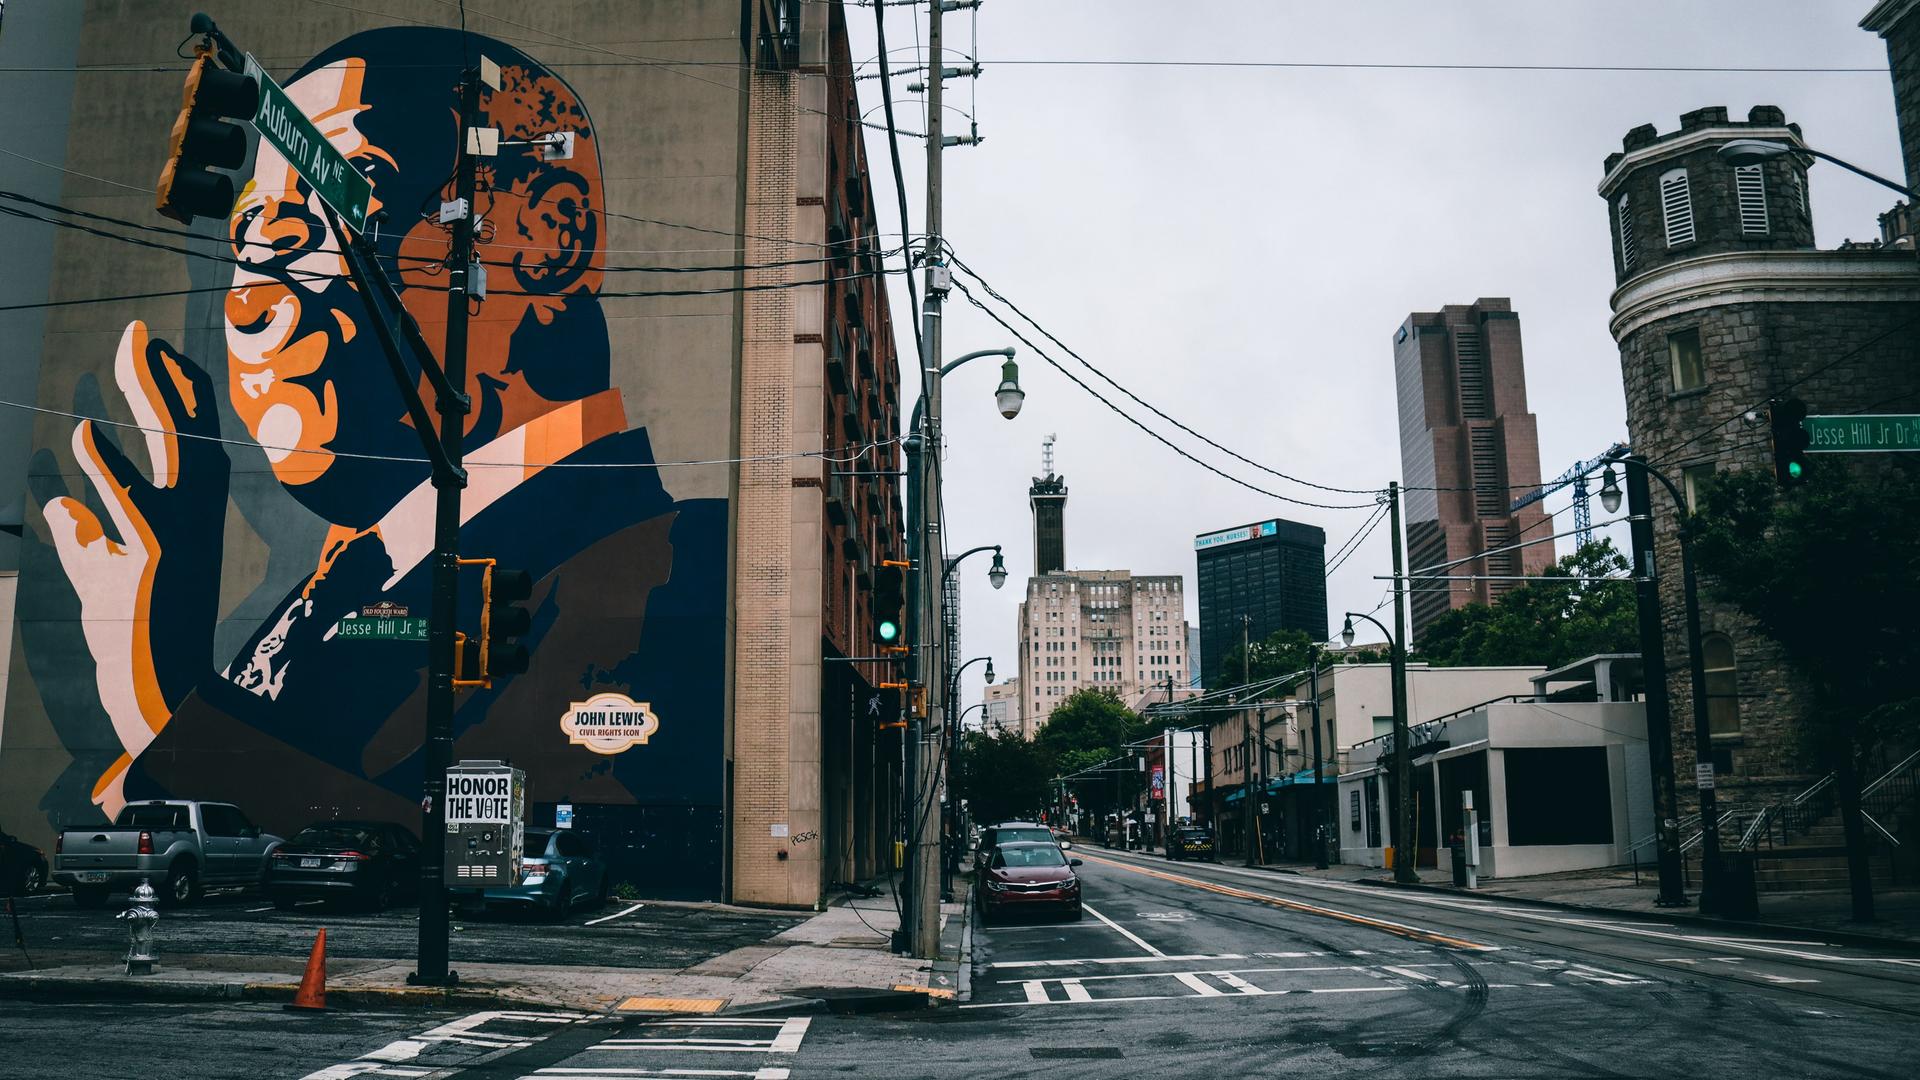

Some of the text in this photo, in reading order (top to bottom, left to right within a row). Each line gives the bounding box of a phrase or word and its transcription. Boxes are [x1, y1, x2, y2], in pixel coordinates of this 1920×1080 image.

[259, 89, 345, 185] Auburn Av NE
[1809, 422, 1909, 445] Jesse Hill Jr Dr
[1196, 539, 1212, 547] THANK
[338, 620, 371, 635] Jesse
[377, 620, 394, 635] Hill
[419, 620, 426, 628] DR
[418, 629, 427, 637] NE
[575, 711, 645, 726] JOHN LEWIS
[579, 729, 640, 737] CIVIL RIGHTS ICON
[448, 777, 509, 796] HONOR
[448, 797, 508, 819] THE VOTE
